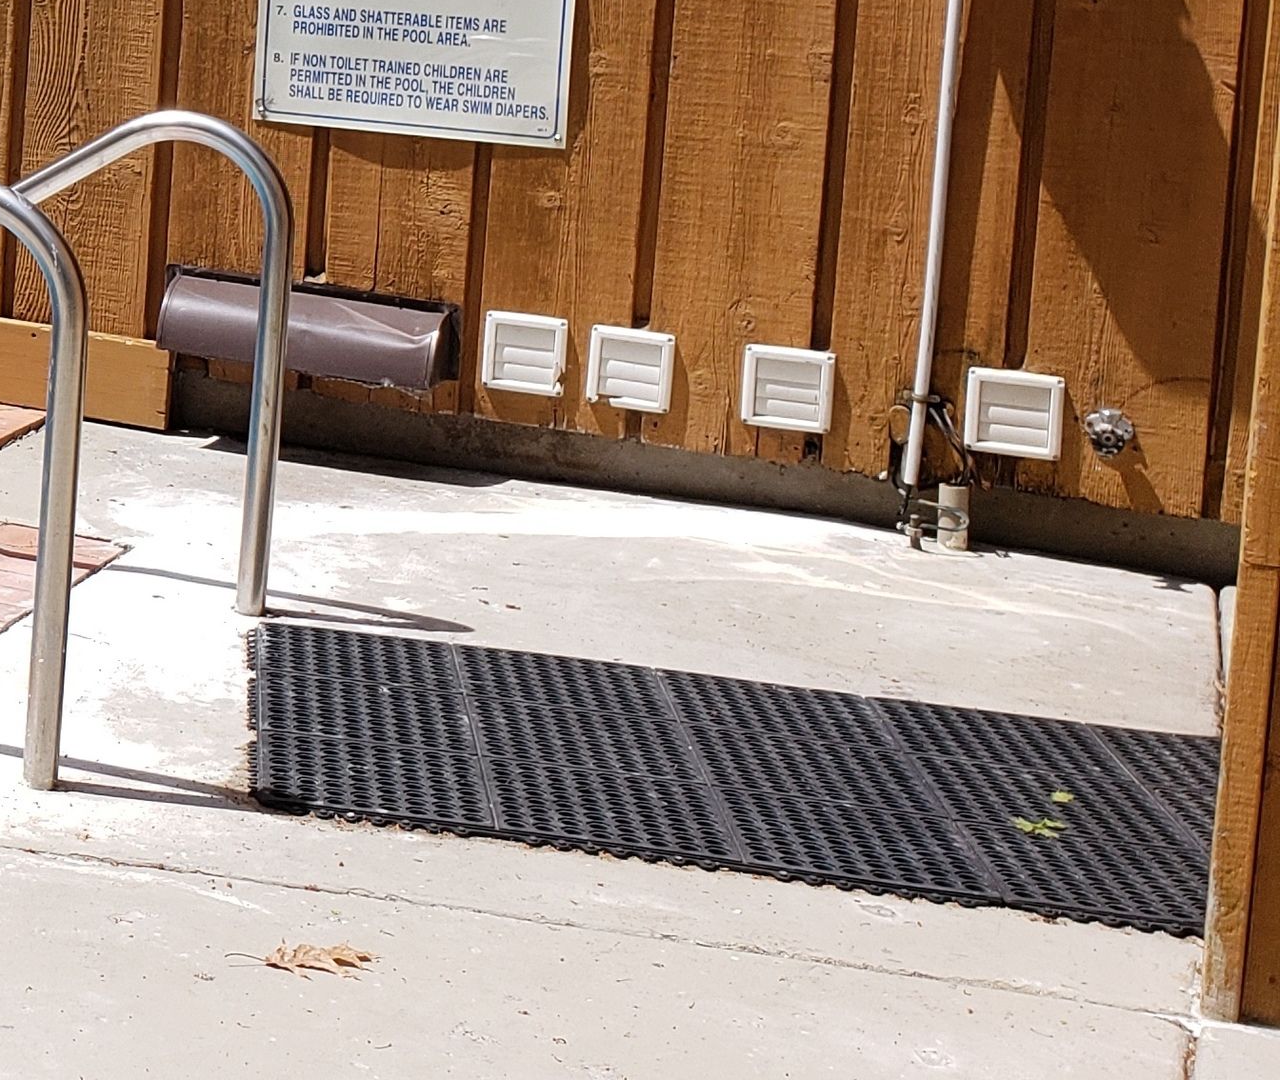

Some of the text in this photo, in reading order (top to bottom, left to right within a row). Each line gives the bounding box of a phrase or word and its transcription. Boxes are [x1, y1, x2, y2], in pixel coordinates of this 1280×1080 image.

[276, 5, 507, 33] 7. GLASS AND SHATTERABLE ITEMS ARE
[292, 21, 472, 46] PROHIBITED IN THE POOL AREA.
